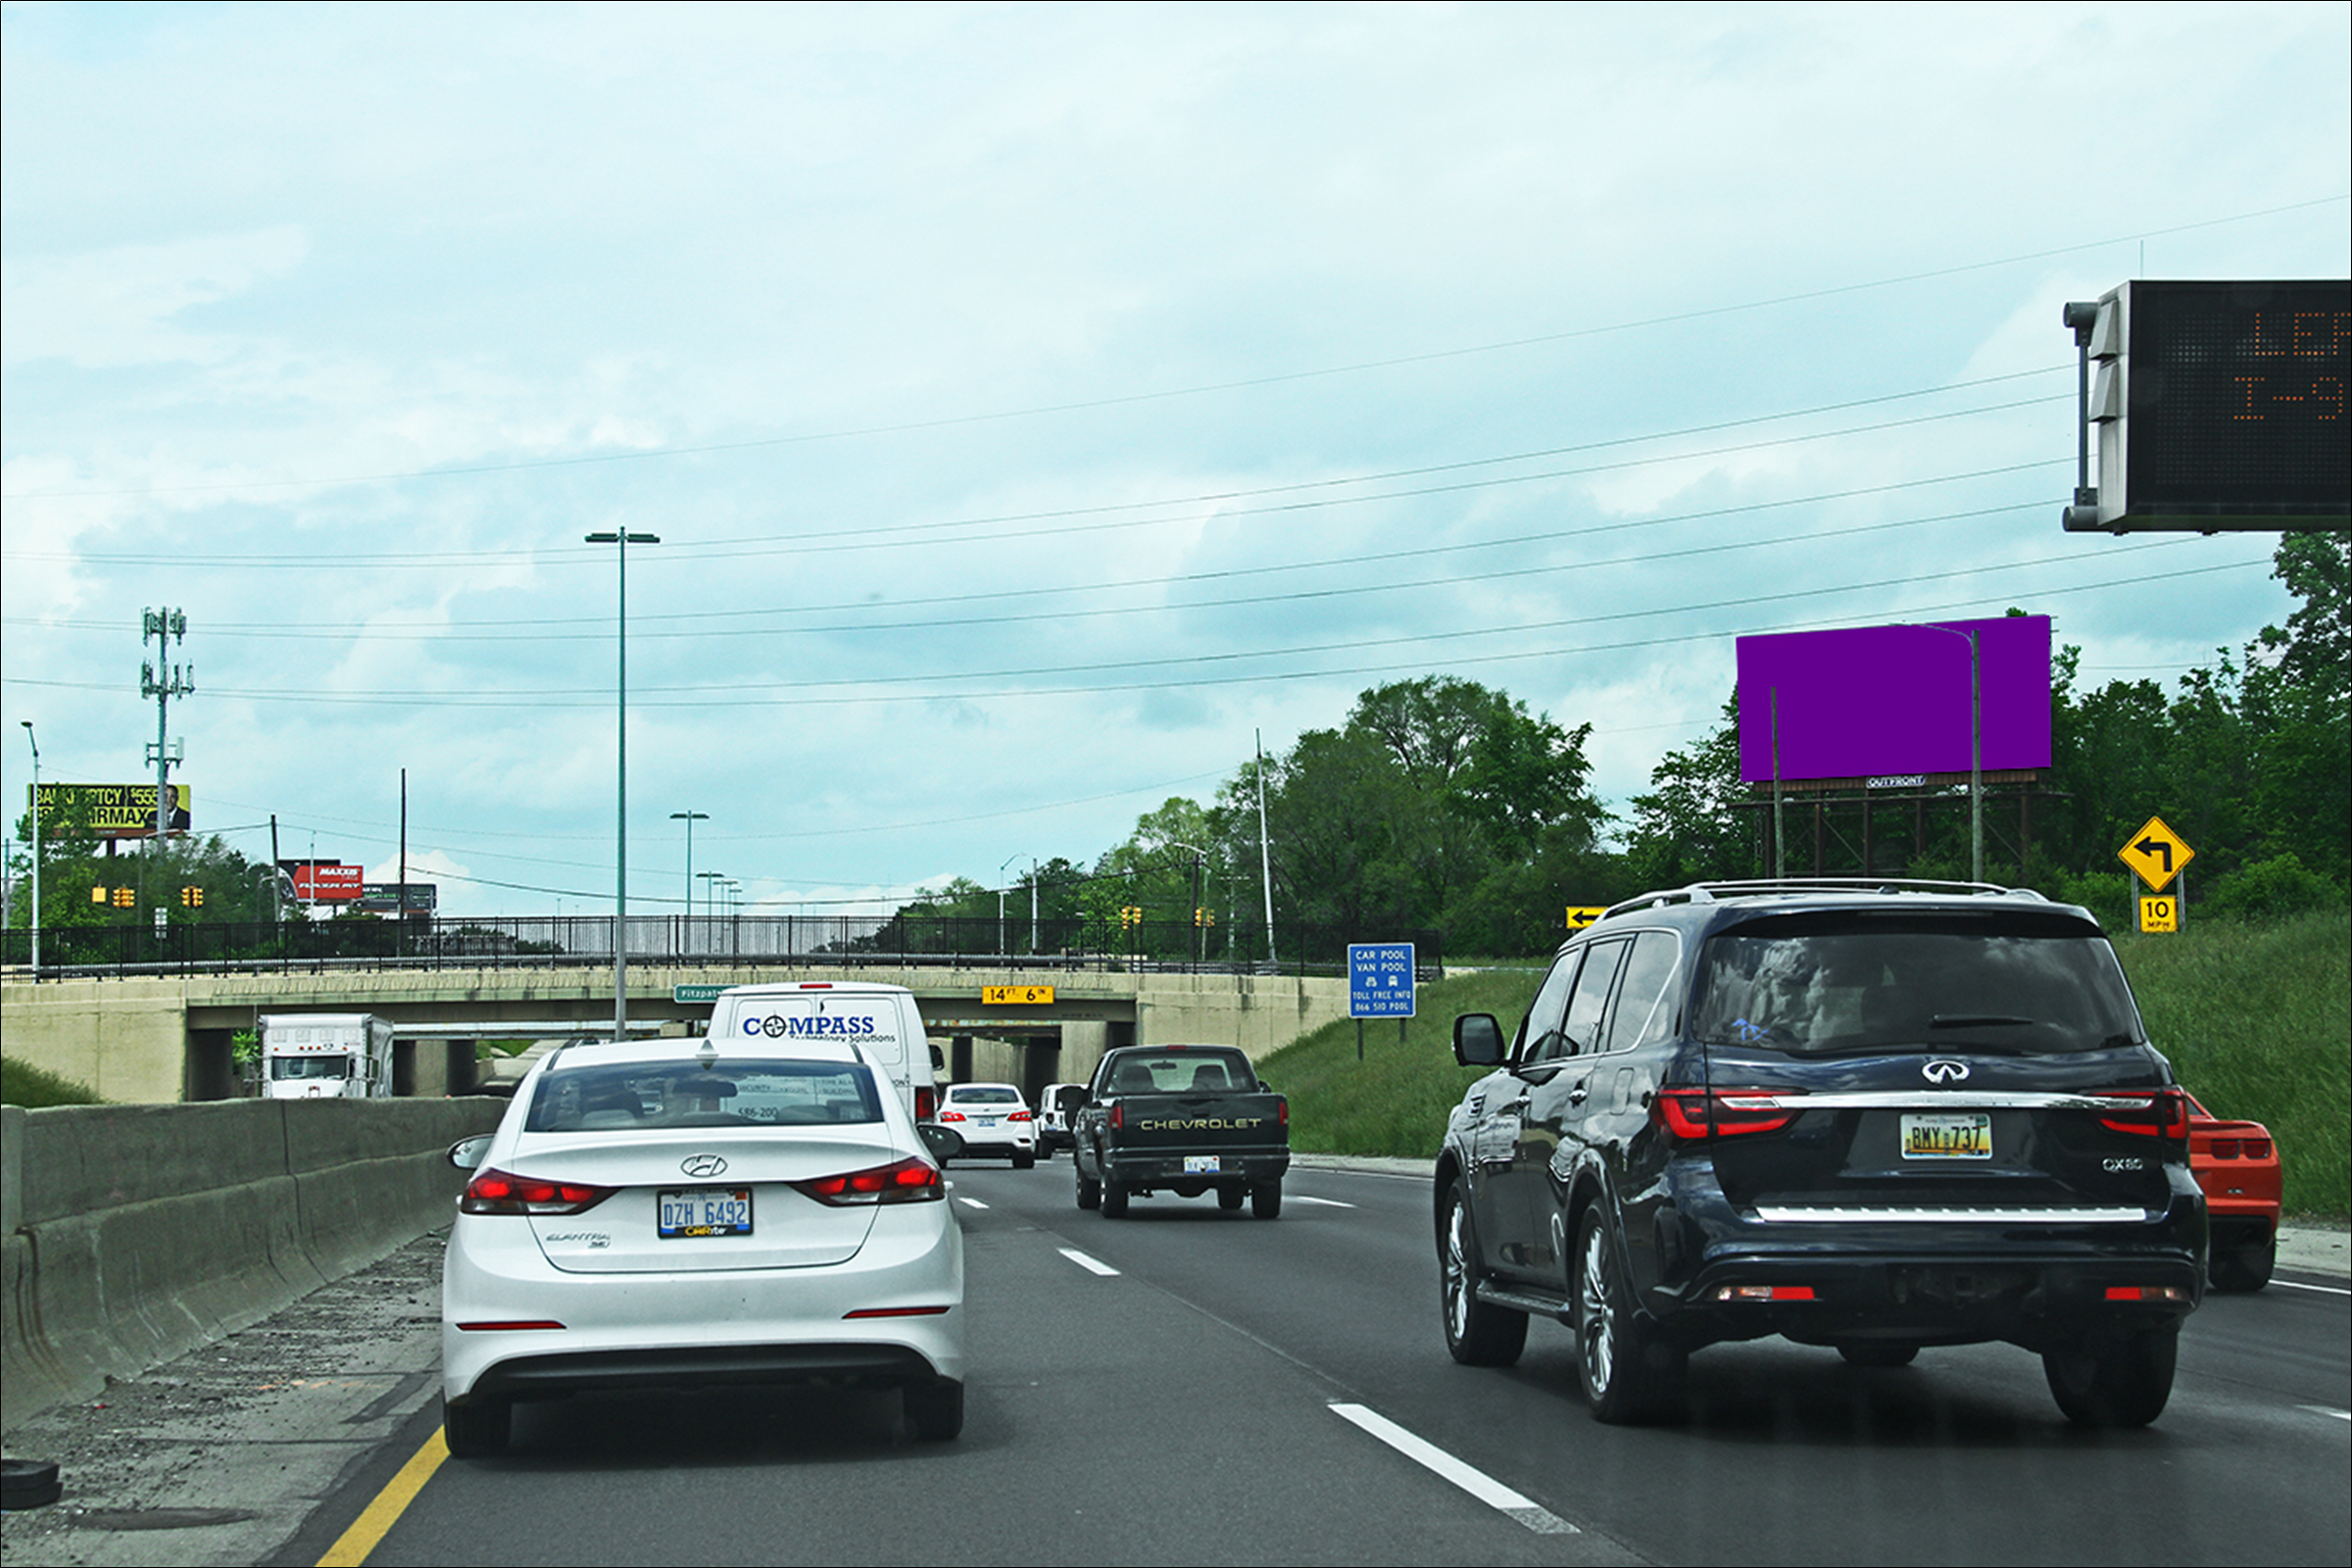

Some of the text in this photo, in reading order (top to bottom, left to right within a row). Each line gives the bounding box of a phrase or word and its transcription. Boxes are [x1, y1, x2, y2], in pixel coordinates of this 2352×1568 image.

[2233, 376, 2344, 420] I-9
[1867, 775, 1925, 788] OUTFRONT
[2146, 901, 2169, 918] 10
[1355, 950, 1406, 960] CAR POOL
[1355, 962, 1406, 972] VAN POOL
[990, 988, 1005, 1002] 14
[1026, 988, 1036, 1002] 6
[1352, 990, 1411, 1000] TOLL FREE INFO
[743, 1015, 874, 1038] COMPASS
[849, 1033, 896, 1043] Solutions
[1141, 1118, 1261, 1131] CHEVROLET
[1912, 1126, 1982, 1150] BMY 737
[2101, 1157, 2144, 1173] QX80
[663, 1200, 747, 1226] DZH 6492
[546, 1232, 611, 1241] ELANTRA
